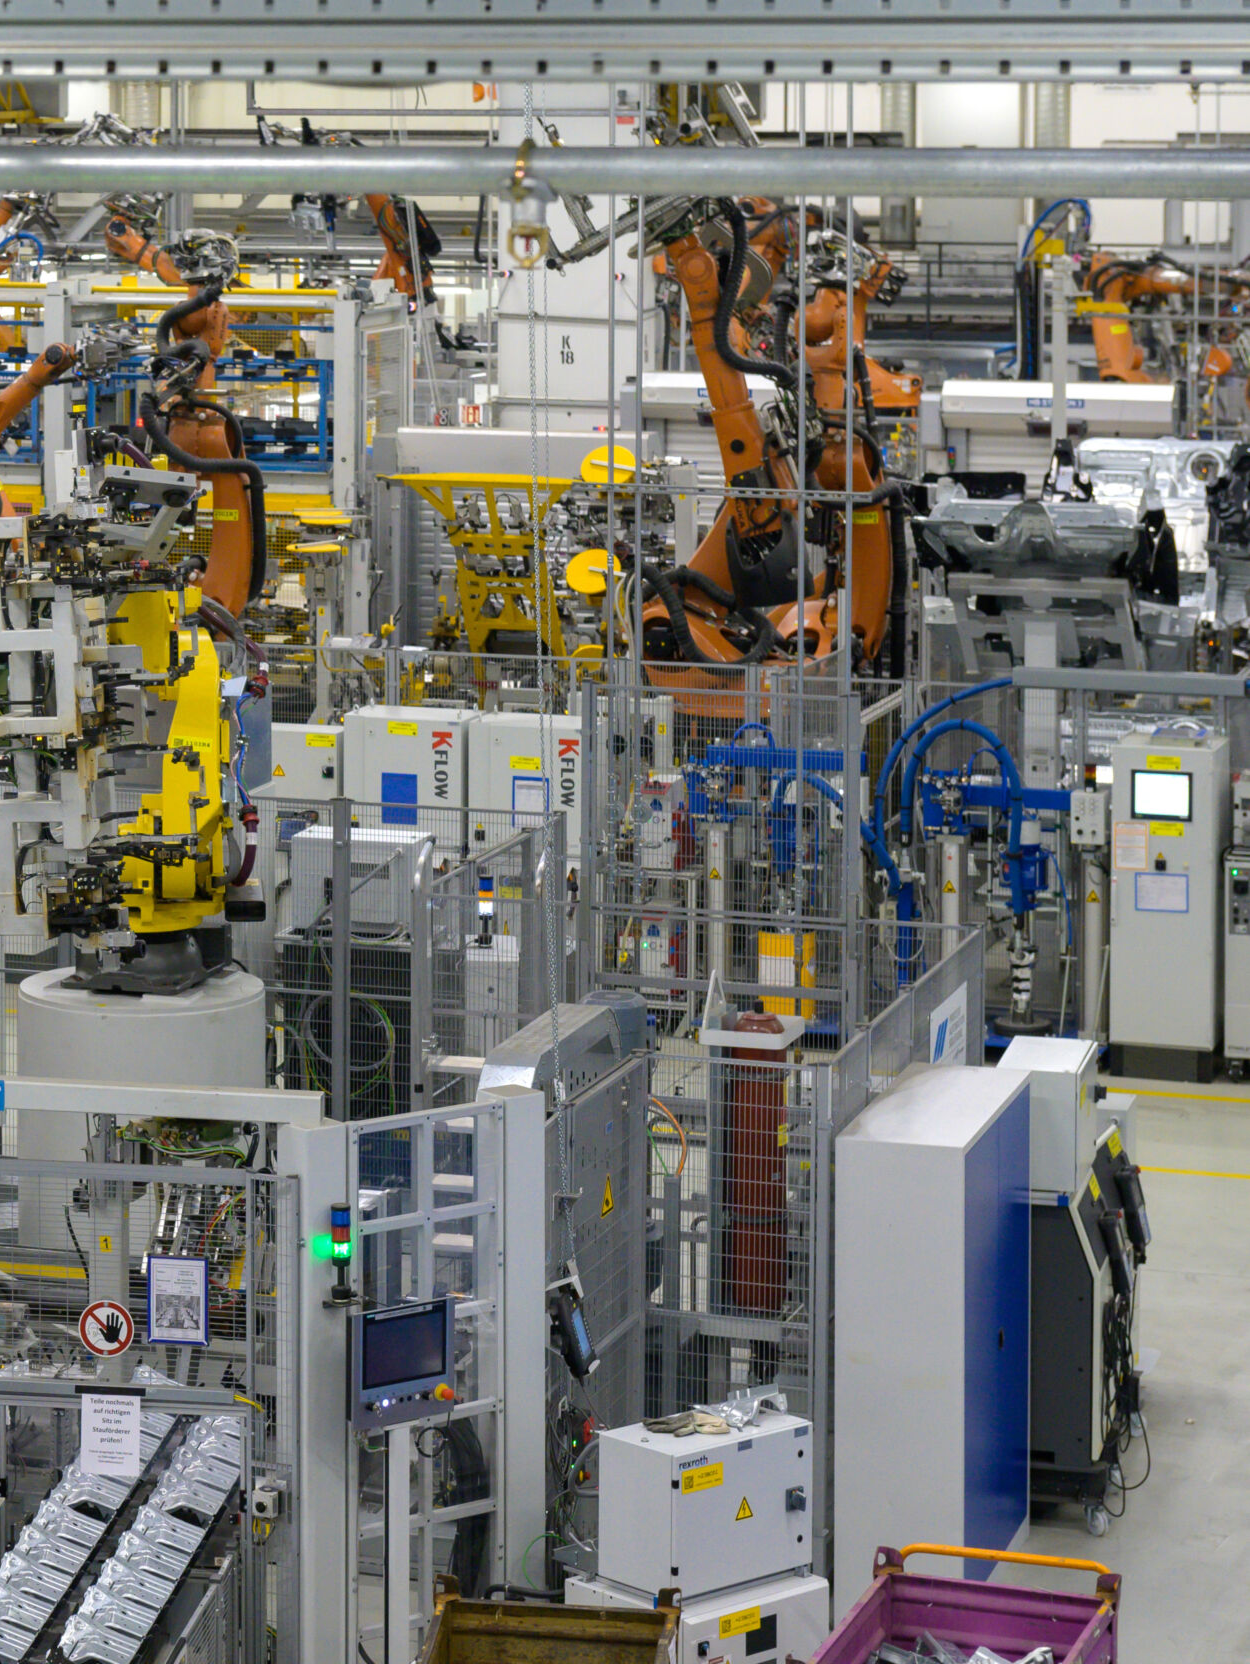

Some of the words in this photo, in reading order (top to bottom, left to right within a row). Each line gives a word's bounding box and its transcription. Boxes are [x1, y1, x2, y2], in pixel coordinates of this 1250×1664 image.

[562, 335, 571, 350] K
[560, 350, 575, 365] 18
[106, 1399, 134, 1407] nochmals
[105, 1408, 131, 1417] richtigen
[678, 1454, 709, 1470] rexroth
